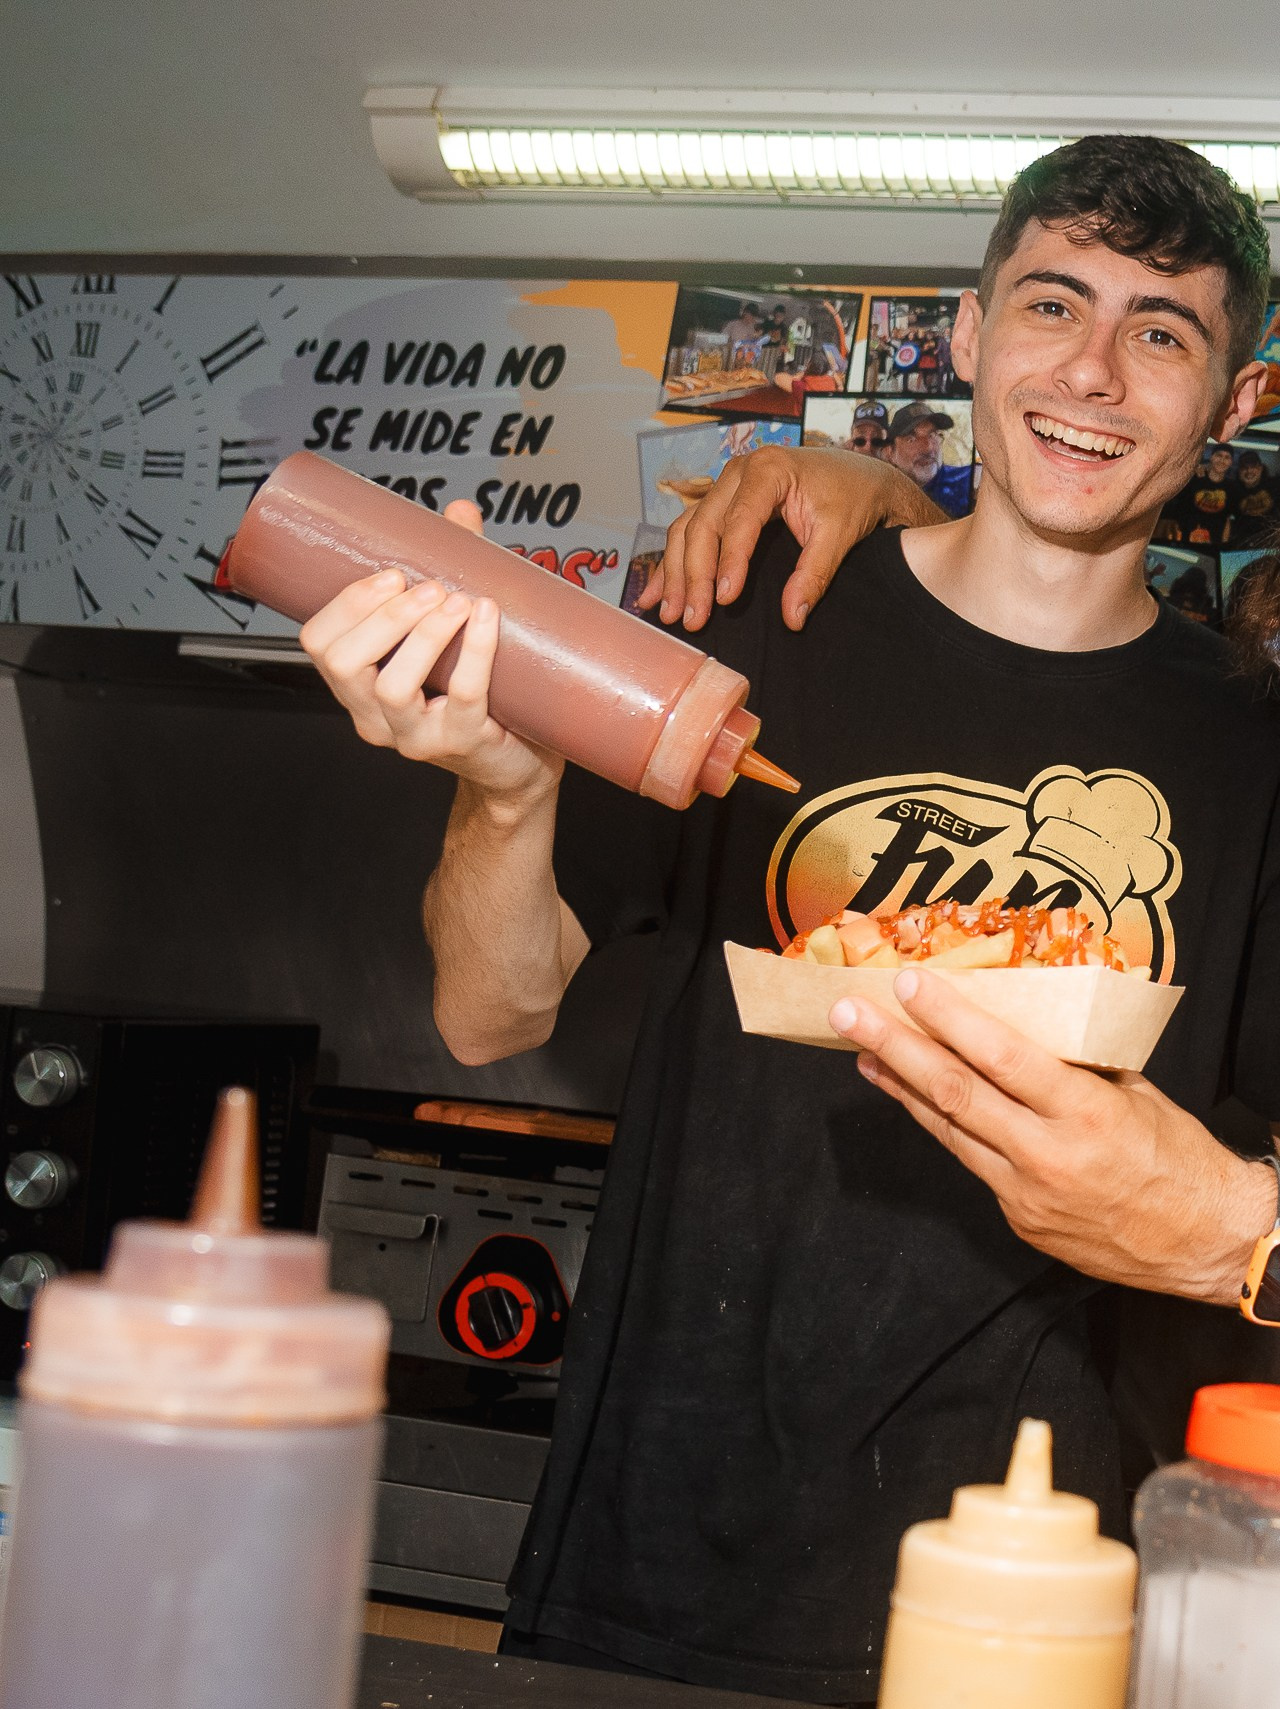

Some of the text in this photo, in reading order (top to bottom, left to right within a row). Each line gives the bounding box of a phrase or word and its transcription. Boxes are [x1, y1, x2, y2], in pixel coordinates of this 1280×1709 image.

[384, 340, 487, 389] VIDA
[495, 344, 567, 391] NO
[303, 406, 555, 457] SE MIDE EN
[474, 479, 582, 529] SINO
[896, 802, 981, 841] STREET
